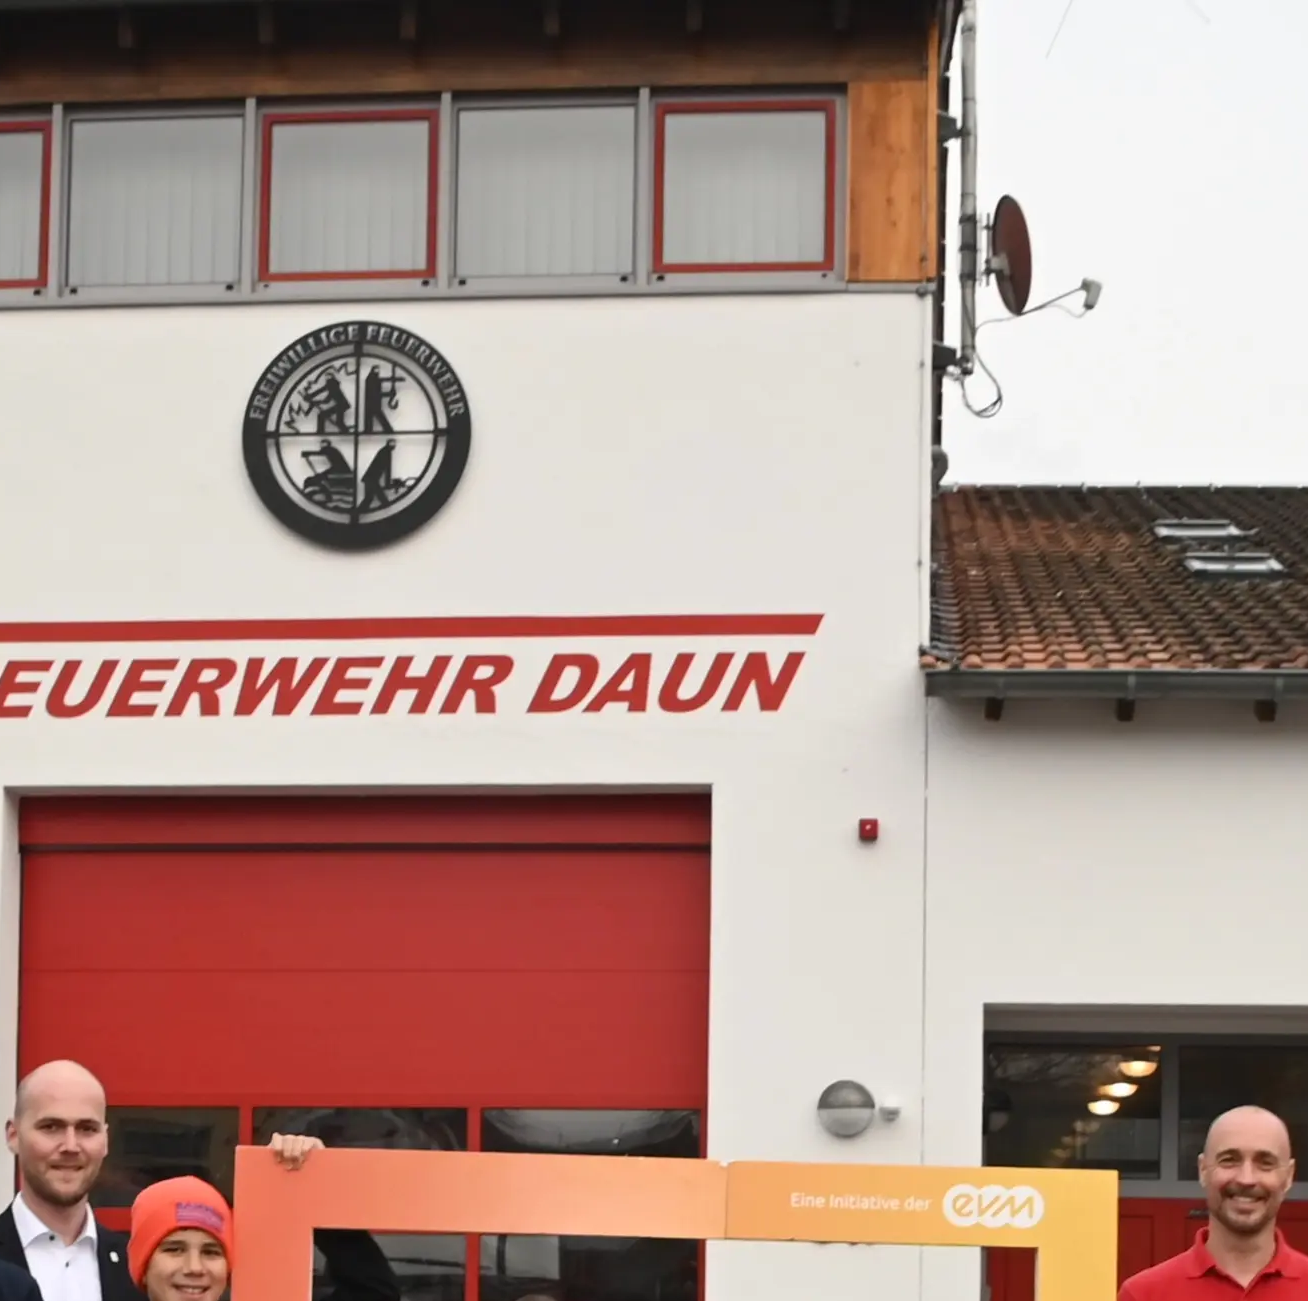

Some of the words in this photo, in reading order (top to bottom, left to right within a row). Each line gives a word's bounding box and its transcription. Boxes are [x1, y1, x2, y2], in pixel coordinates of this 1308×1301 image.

[249, 324, 360, 421] FREIWILLIGE
[366, 324, 465, 417] FEUERWEHR
[527, 651, 807, 714] DAUN
[789, 1192, 826, 1209] Eine
[829, 1192, 900, 1211] Initiative
[903, 1194, 933, 1212] der
[950, 1190, 1036, 1220] evm
